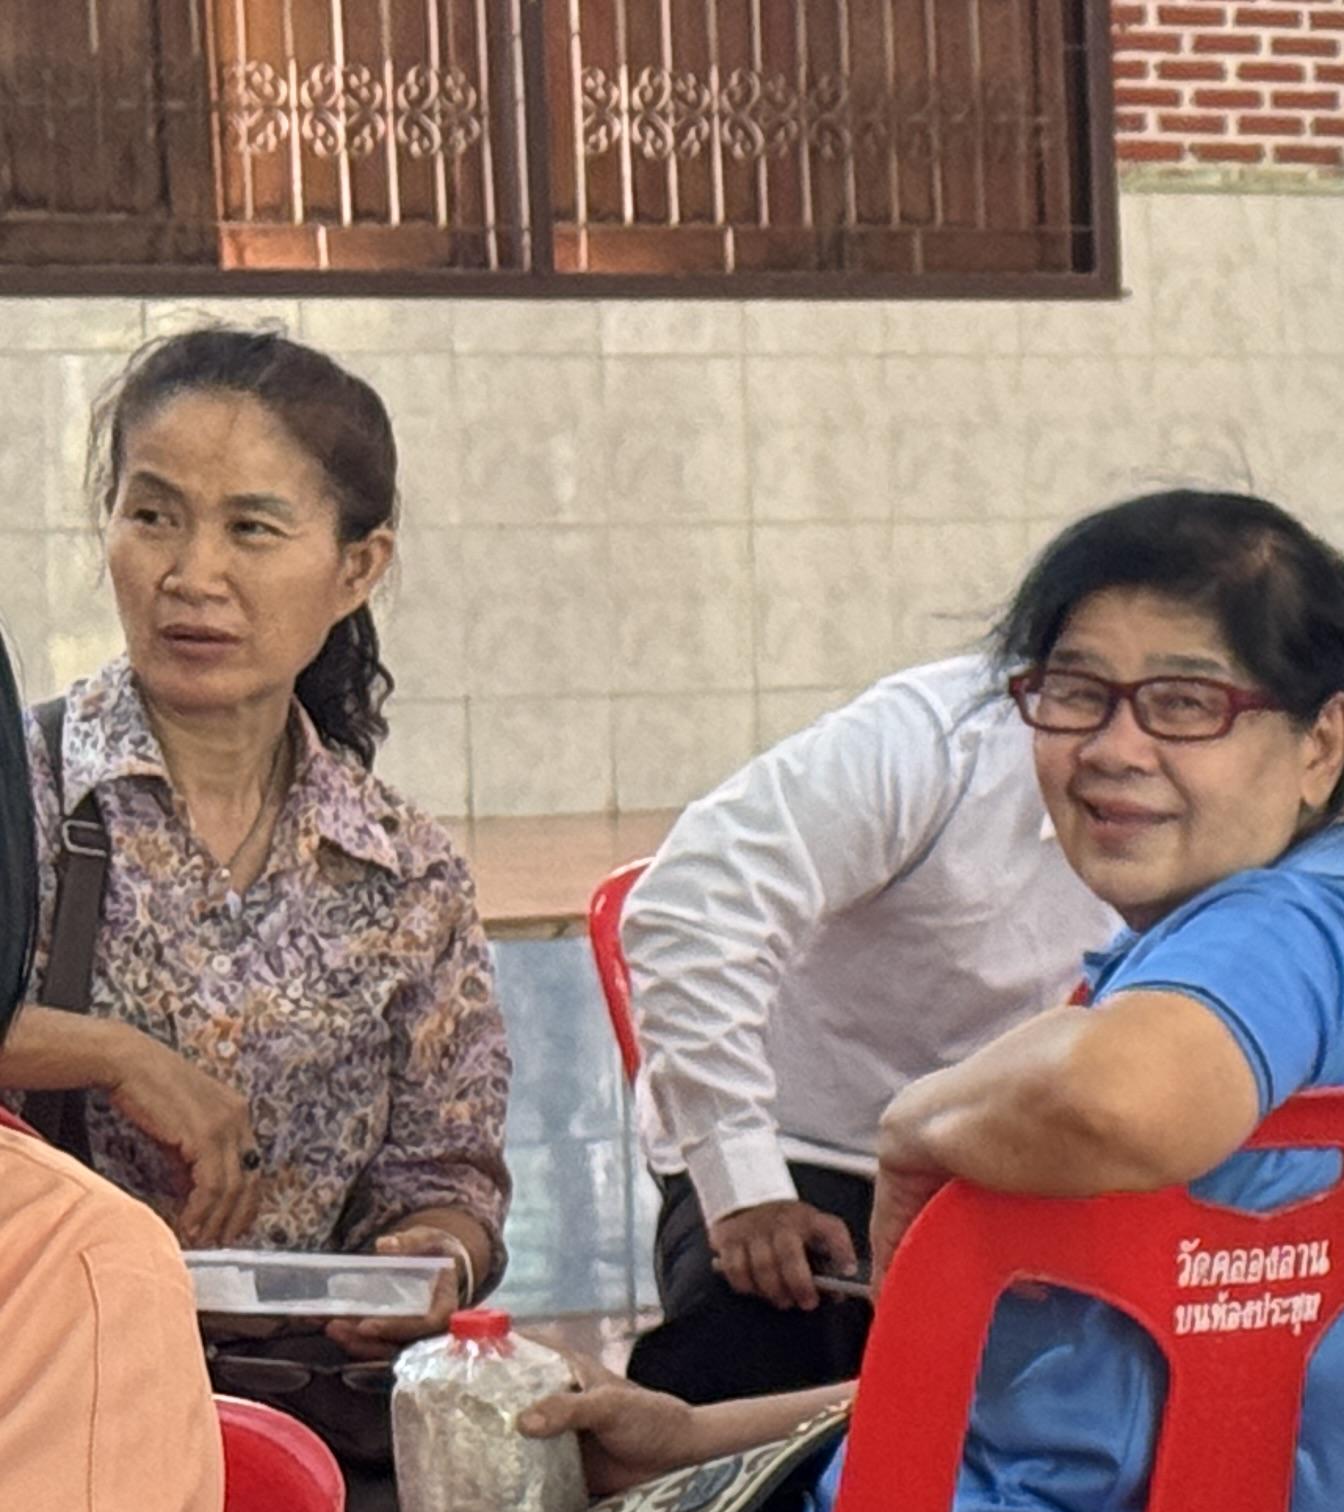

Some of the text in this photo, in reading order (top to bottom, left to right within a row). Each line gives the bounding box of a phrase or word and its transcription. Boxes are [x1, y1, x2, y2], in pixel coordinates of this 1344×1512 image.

[1175, 1237, 1331, 1288] วัดคลองลาน
[1174, 1291, 1322, 1336] บนห้องประชุม
